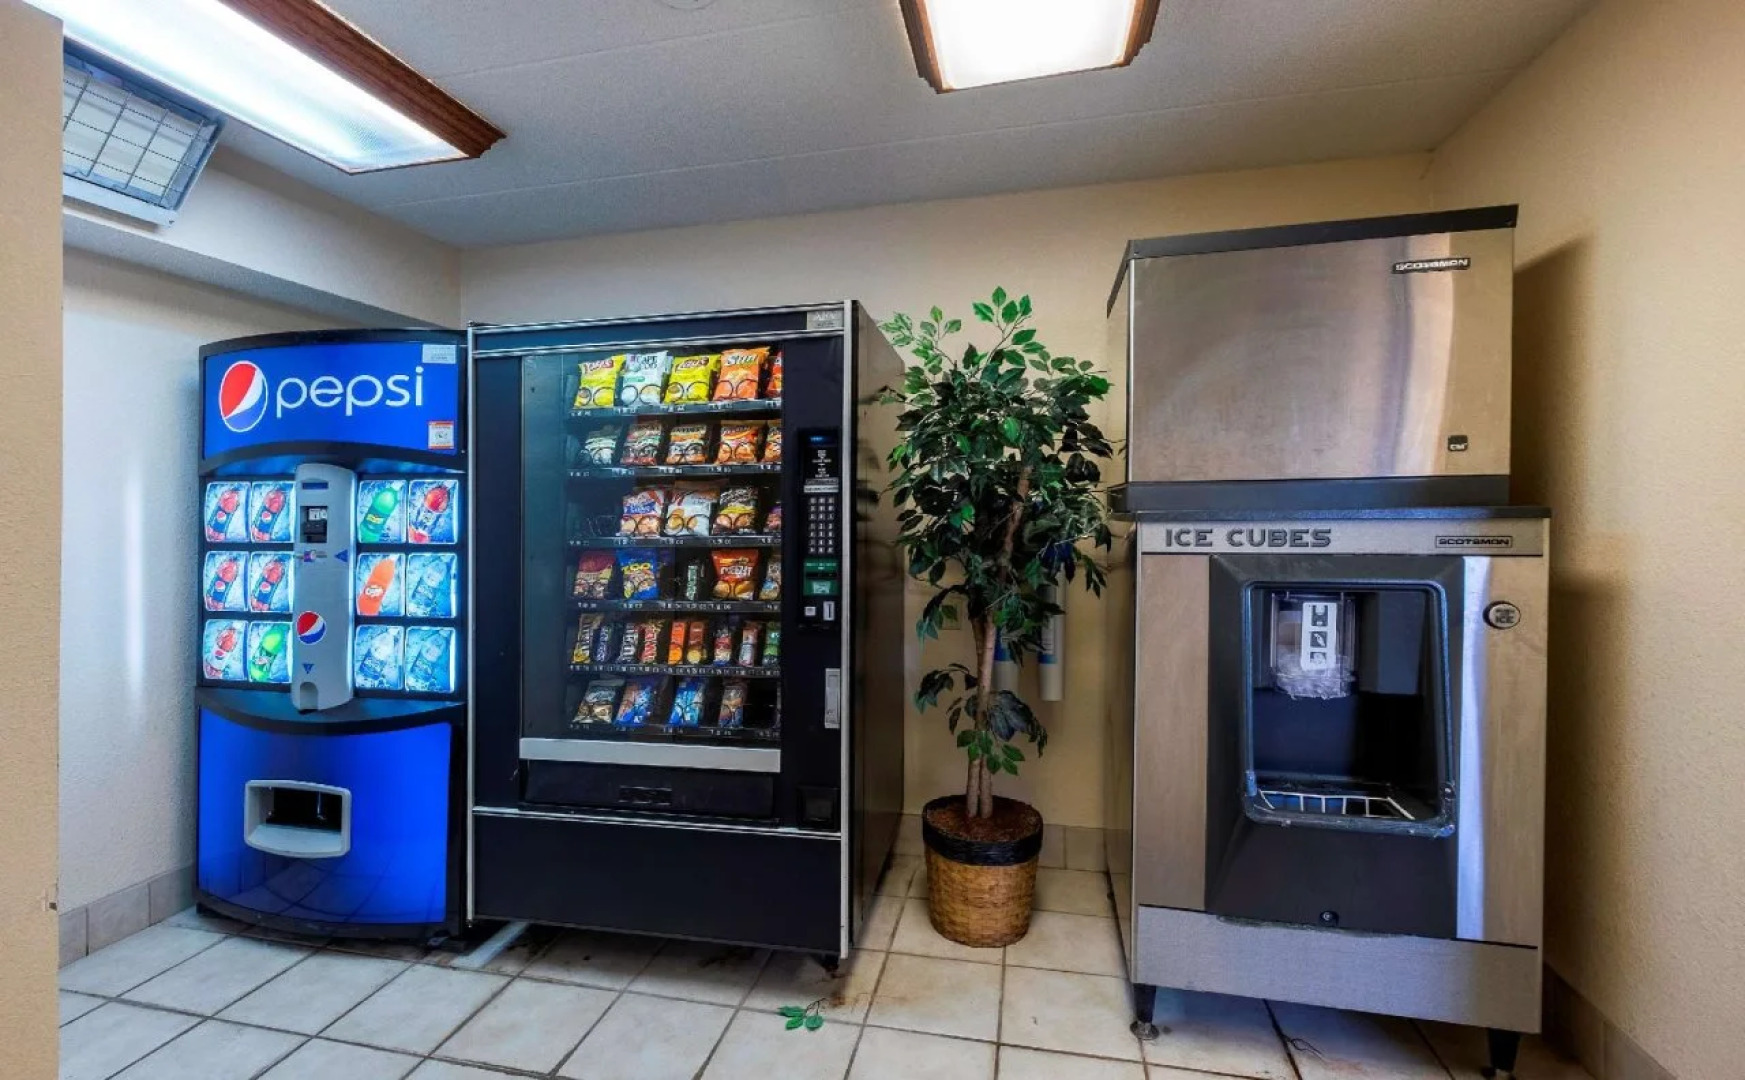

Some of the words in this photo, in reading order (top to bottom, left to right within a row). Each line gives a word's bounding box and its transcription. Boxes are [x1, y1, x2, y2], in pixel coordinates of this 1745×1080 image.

[276, 366, 424, 419] pepsi
[1165, 528, 1213, 547] ICE
[1225, 528, 1332, 548] CUBES
